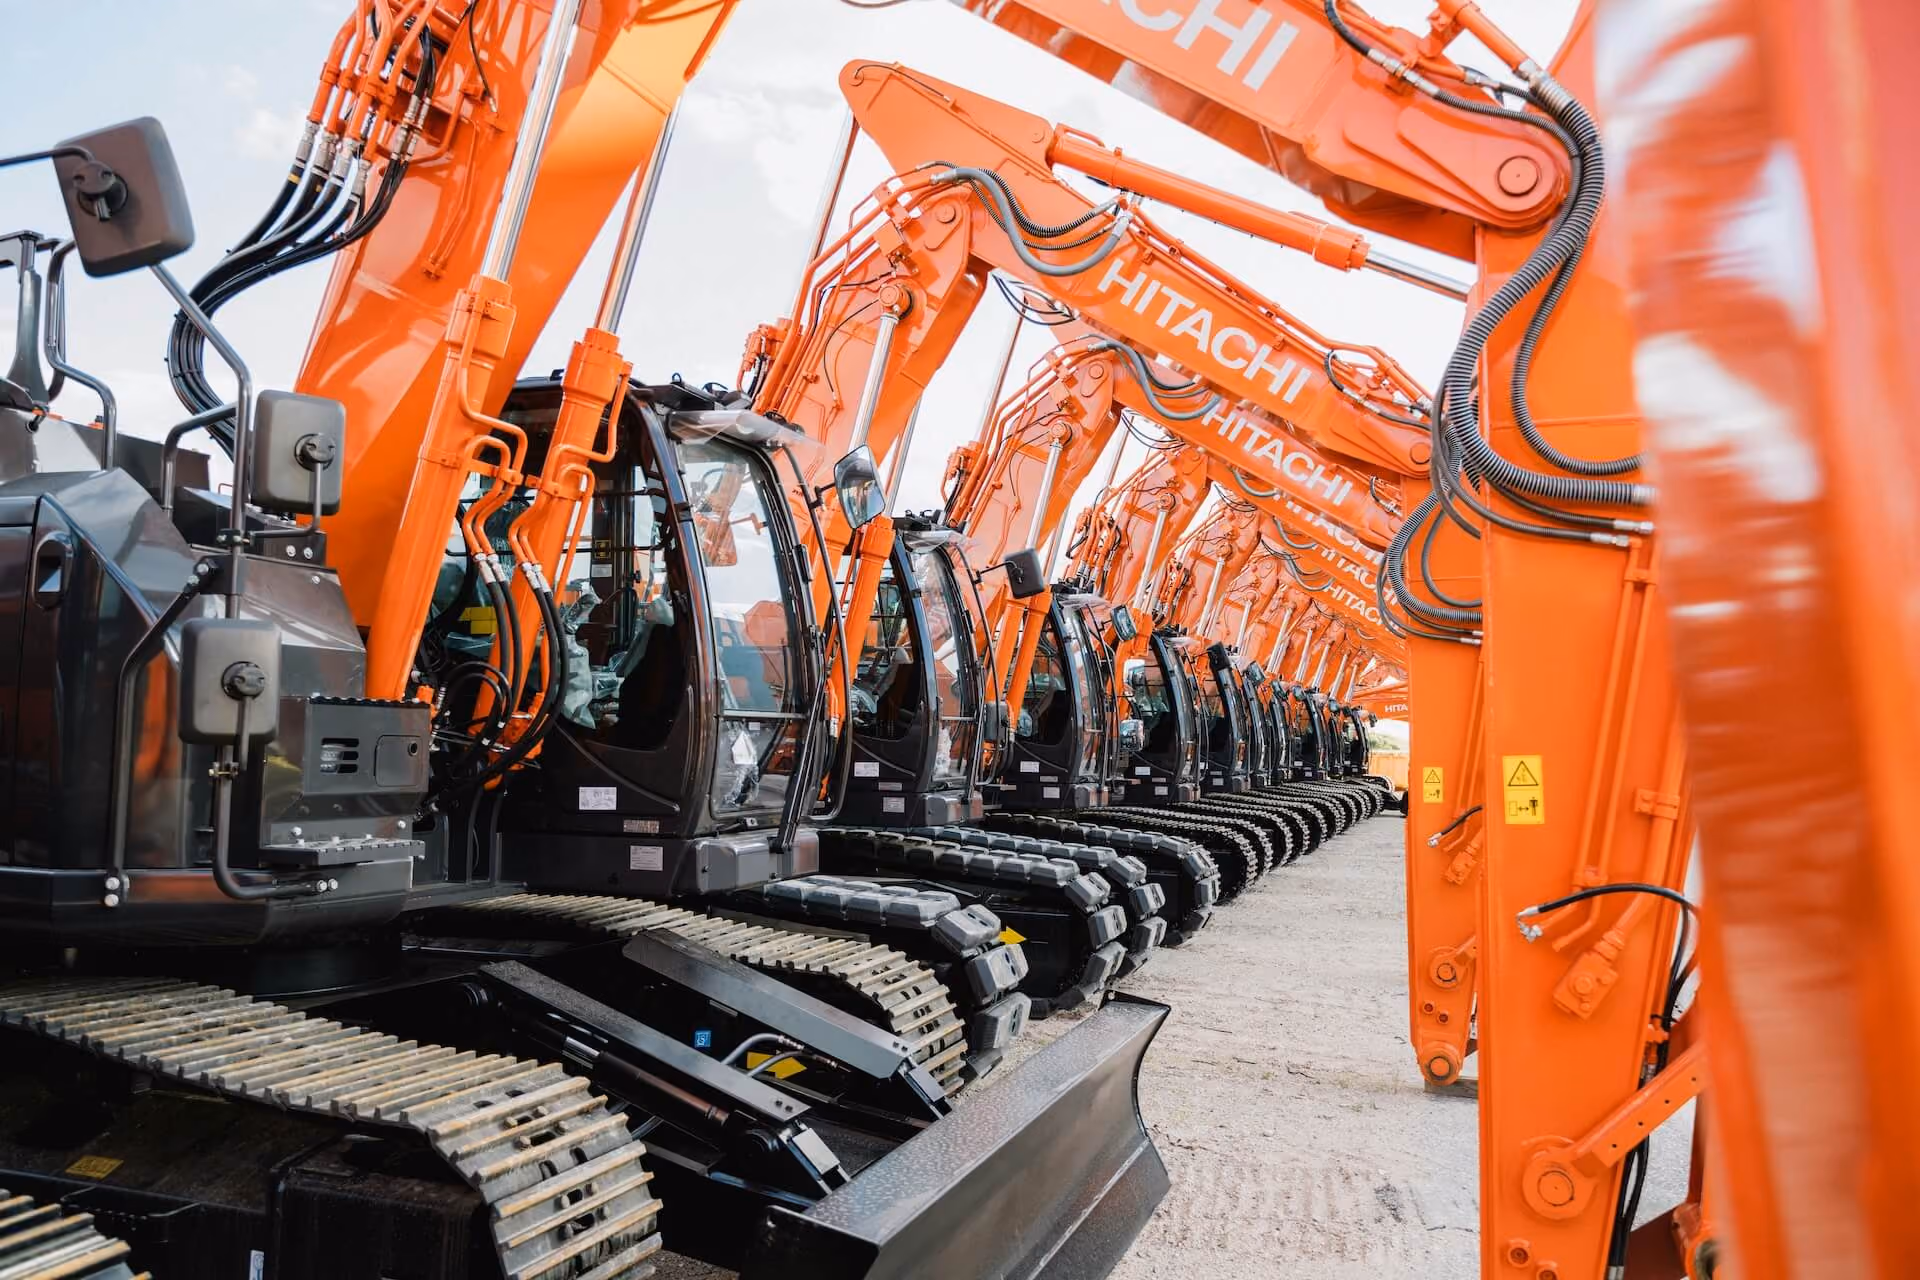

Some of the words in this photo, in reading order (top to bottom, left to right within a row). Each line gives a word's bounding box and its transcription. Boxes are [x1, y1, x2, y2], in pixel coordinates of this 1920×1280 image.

[1097, 259, 1312, 404] HITACHI
[1201, 403, 1352, 506] HITACHI
[1323, 583, 1399, 634] HITAC
